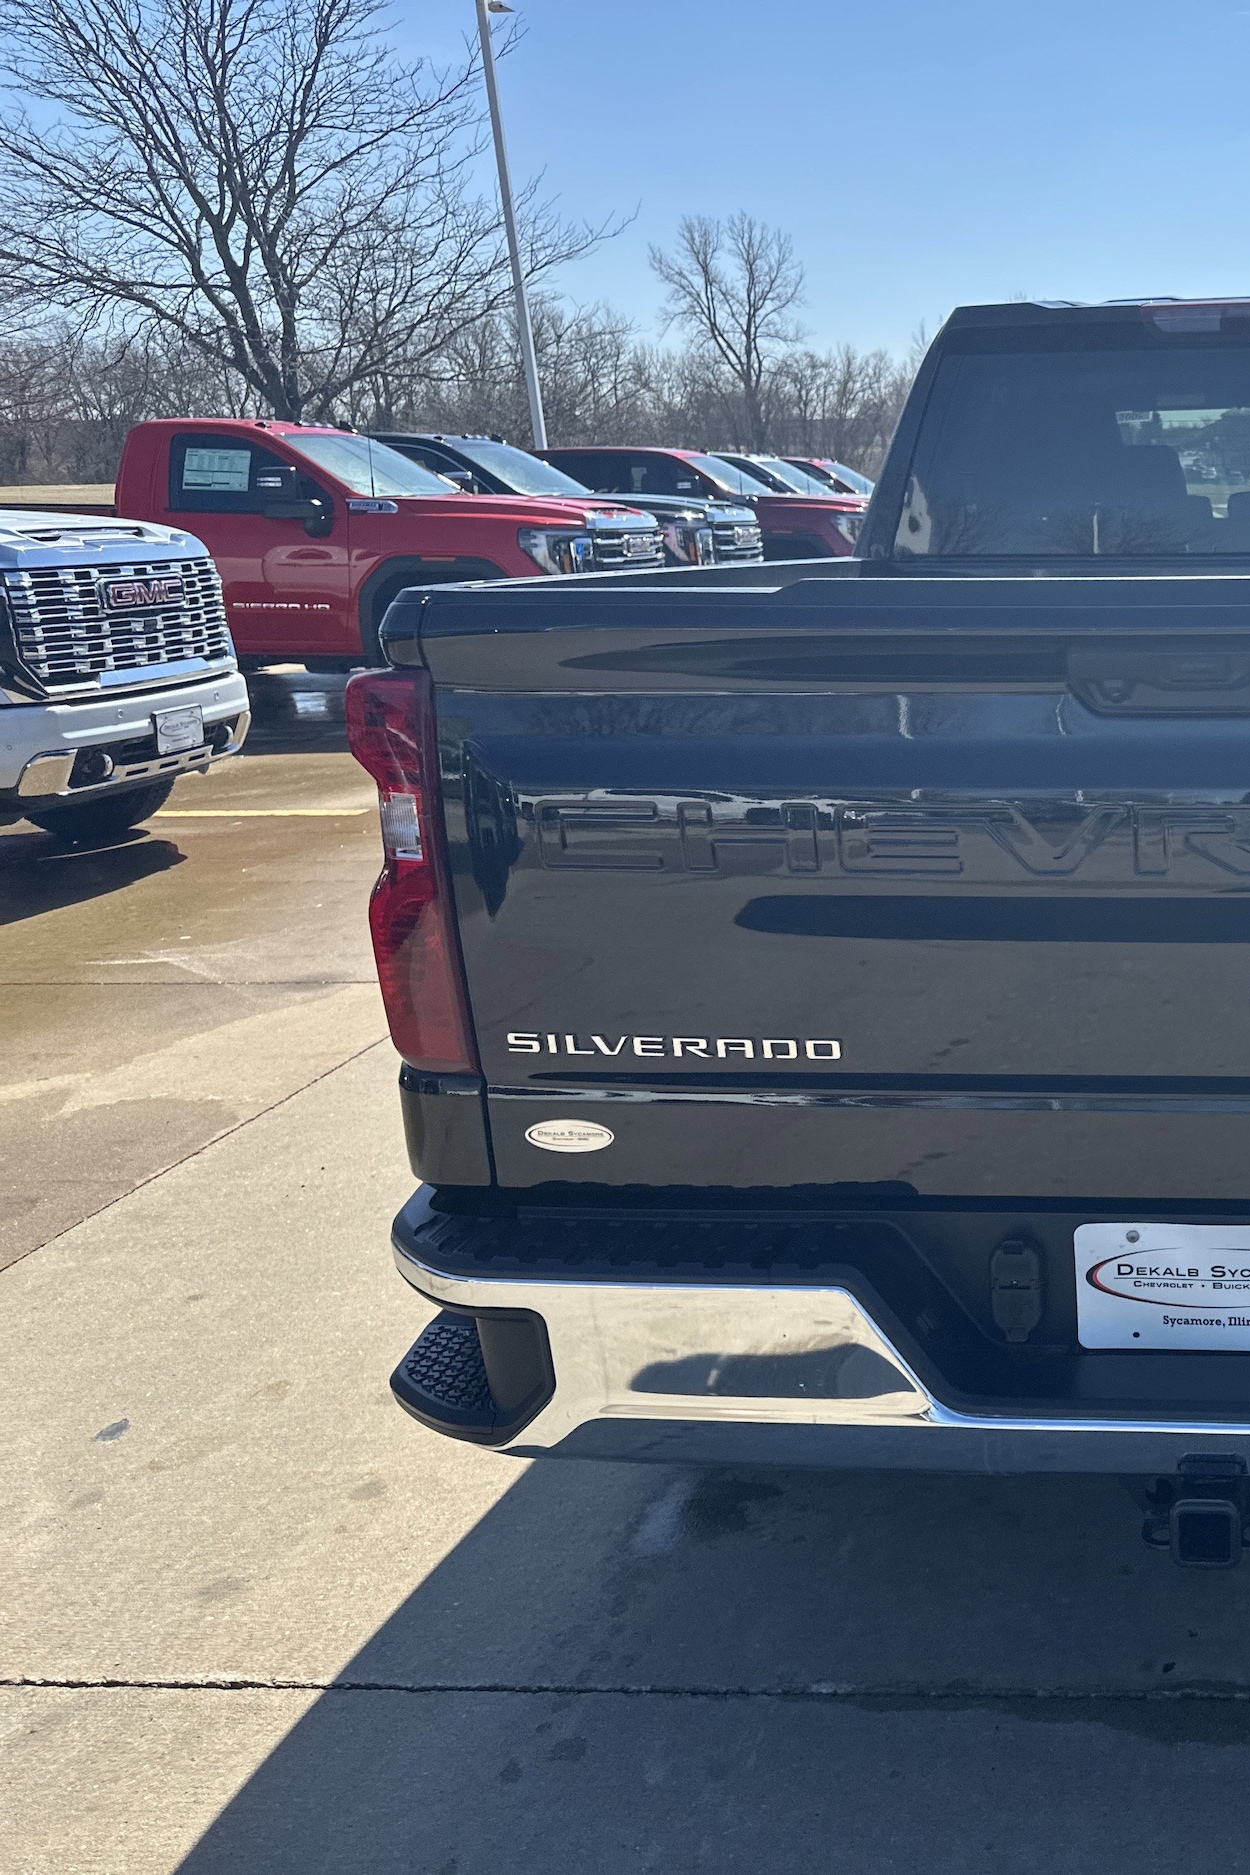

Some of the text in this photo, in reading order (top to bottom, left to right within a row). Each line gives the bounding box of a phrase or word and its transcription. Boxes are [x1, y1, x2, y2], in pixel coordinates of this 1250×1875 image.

[110, 579, 184, 606] GMC
[506, 1032, 842, 1060] SILVERADO
[1117, 1263, 1200, 1278] DEKALB
[1133, 1280, 1194, 1289] CHEVROLET
[1212, 1282, 1250, 1290] BUICK
[1162, 1315, 1226, 1328] Sycamore,
